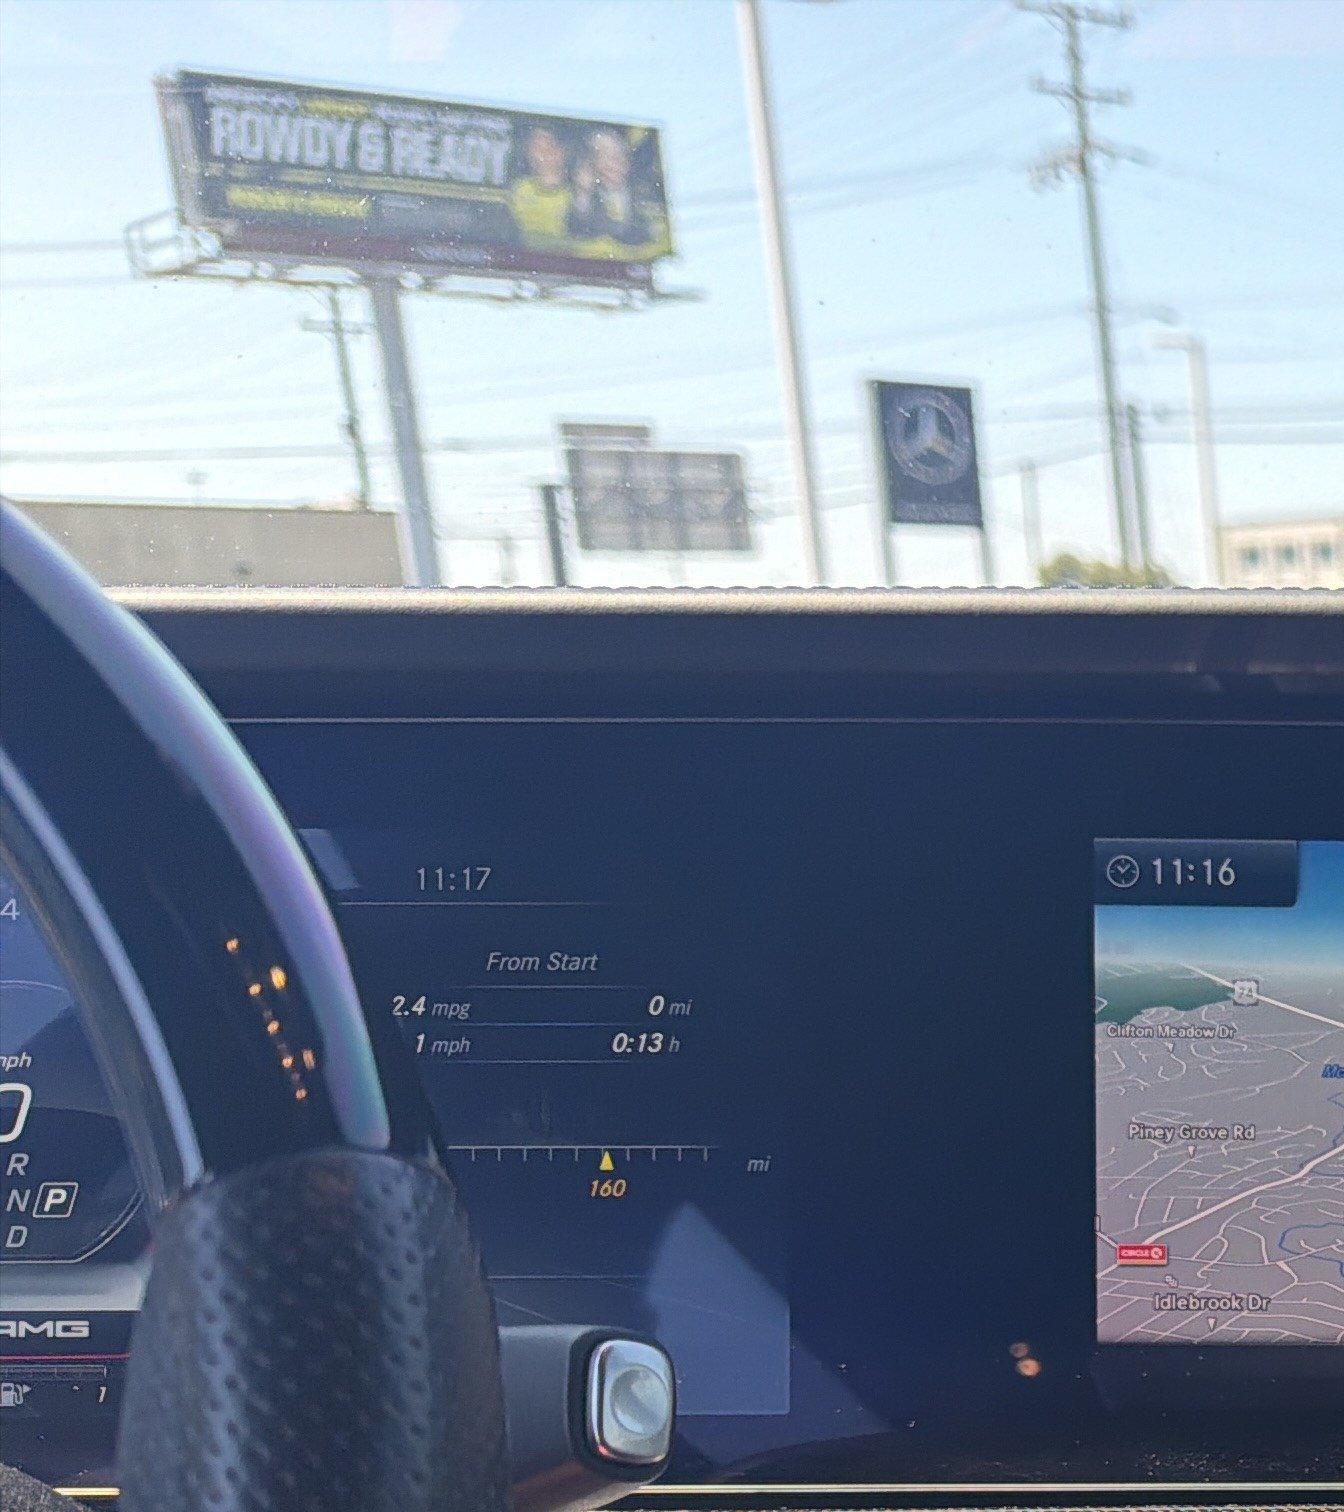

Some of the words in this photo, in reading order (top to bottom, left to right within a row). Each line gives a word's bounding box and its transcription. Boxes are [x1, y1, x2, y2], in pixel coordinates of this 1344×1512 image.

[211, 106, 353, 169] ROWDY
[391, 127, 510, 185] READY
[416, 866, 491, 891] 11:17
[1152, 857, 1236, 886] 11:16
[486, 952, 540, 971] From
[546, 952, 598, 971] Start
[431, 1001, 471, 1020] mpg
[648, 995, 665, 1015] 0
[669, 999, 692, 1016] mi
[1108, 1025, 1153, 1038] Clifton
[1158, 1026, 1216, 1038] Meadow
[1219, 1026, 1234, 1038] Dr
[416, 1033, 425, 1053] 1
[431, 1037, 471, 1054] mph
[612, 1033, 663, 1053] 0:13
[668, 1037, 680, 1052] h
[1129, 1125, 1175, 1142] Piney
[1180, 1125, 1229, 1140] Grove
[1233, 1125, 1256, 1140] Rd
[6, 1153, 30, 1176] R
[747, 1155, 771, 1172] mi
[590, 1179, 627, 1198] 160
[6, 1189, 31, 1212] N
[44, 1188, 67, 1212] P
[5, 1225, 28, 1248] D
[1155, 1294, 1241, 1311] Idlebrook
[1247, 1296, 1270, 1311] Dr
